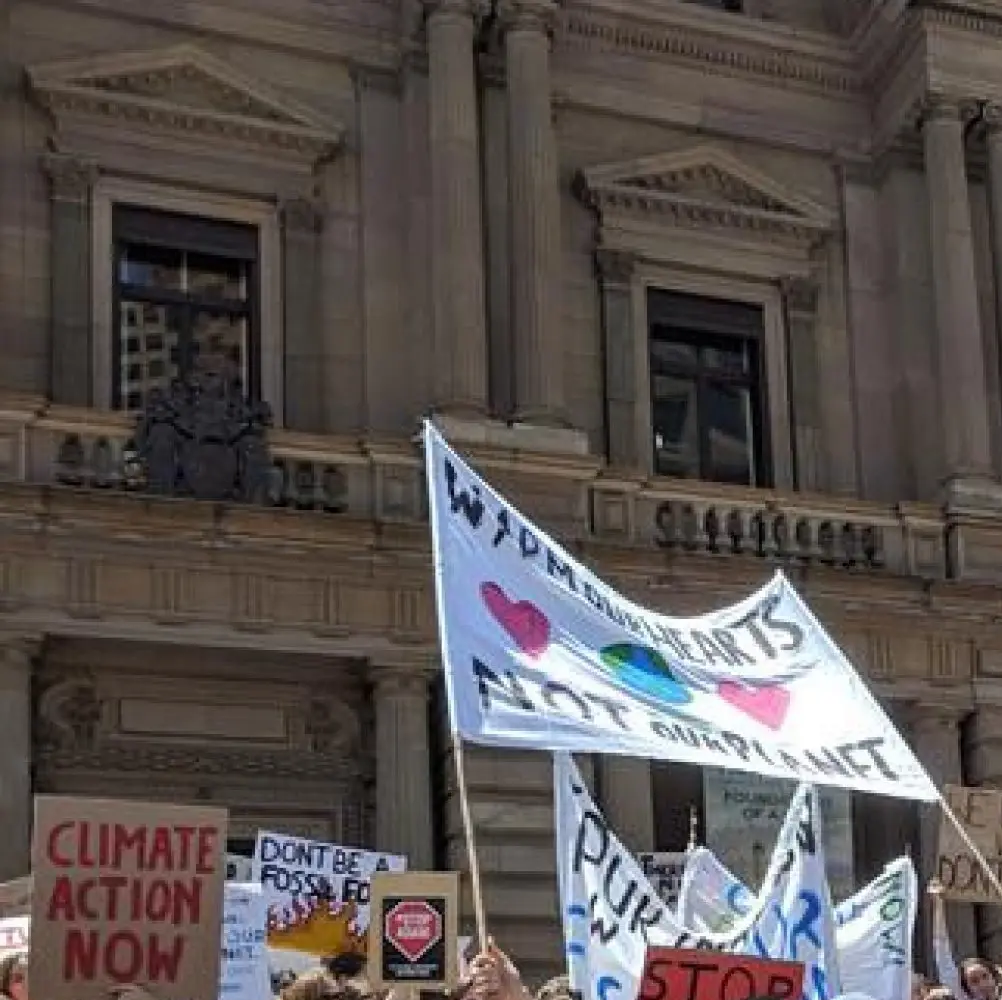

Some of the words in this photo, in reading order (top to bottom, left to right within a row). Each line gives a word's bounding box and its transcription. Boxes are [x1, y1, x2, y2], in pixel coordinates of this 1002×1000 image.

[642, 595, 806, 667] HEARTS
[470, 656, 630, 730] NOT
[721, 729, 898, 781] PLANET
[47, 820, 218, 875] CLIMATE
[333, 848, 361, 876] BE
[47, 876, 201, 925] ACTION
[63, 930, 185, 982] NOW
